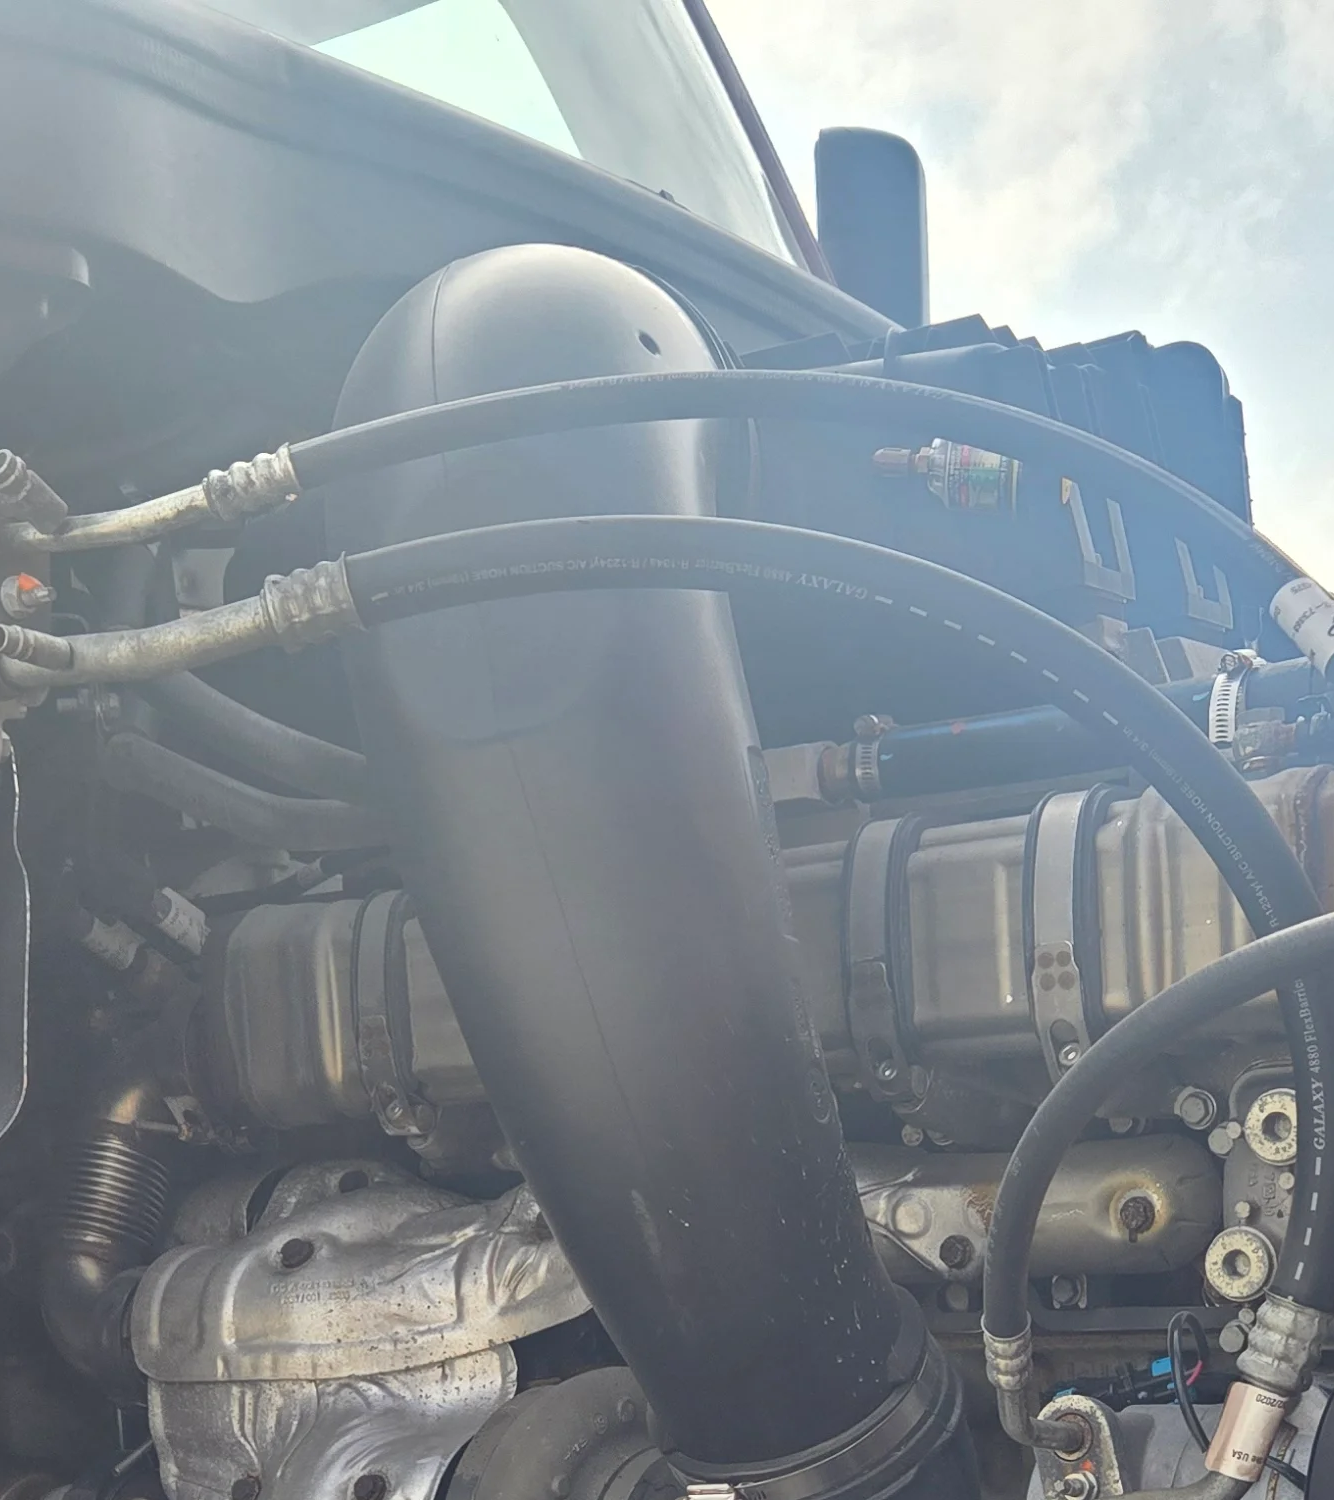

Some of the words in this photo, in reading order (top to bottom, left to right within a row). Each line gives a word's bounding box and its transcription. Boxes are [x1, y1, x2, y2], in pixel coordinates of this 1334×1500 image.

[510, 559, 564, 576] SUCTION
[695, 559, 761, 578] FlexBarrier
[796, 573, 869, 600] GALAXY
[1179, 781, 1210, 814] HOSE
[1204, 813, 1243, 861] SUCTION
[1237, 860, 1256, 882] A/C
[1249, 878, 1280, 928] R-1234yf
[1307, 1044, 1320, 1074] 4880
[1311, 1079, 1326, 1150] GALAXY
[1231, 1449, 1249, 1463] USA
